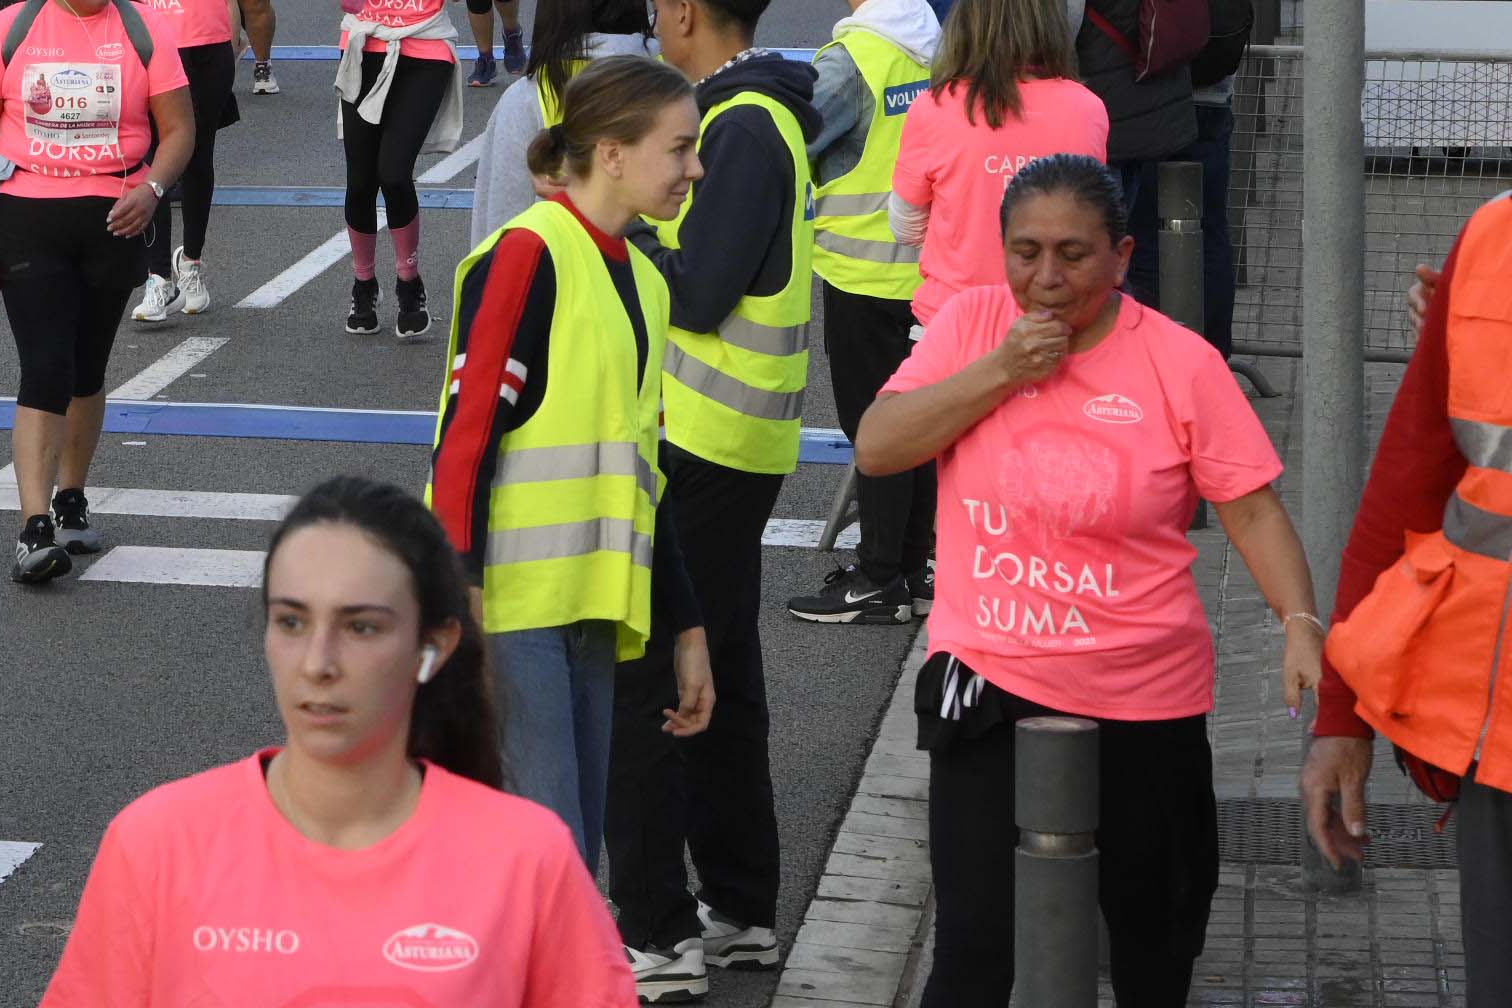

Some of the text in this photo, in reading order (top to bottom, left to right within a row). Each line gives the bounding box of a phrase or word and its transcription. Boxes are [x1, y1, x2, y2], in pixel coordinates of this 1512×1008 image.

[26, 47, 65, 57] OYSHO
[55, 97, 88, 109] 016
[30, 140, 125, 160] DORSAL
[1089, 403, 1140, 418] ASTURIANA
[962, 498, 1008, 536] TU
[972, 545, 1120, 598] DORSAL
[976, 595, 1090, 635] SUMA
[193, 926, 300, 954] OYSHO
[391, 941, 472, 960] ASTURIANA
